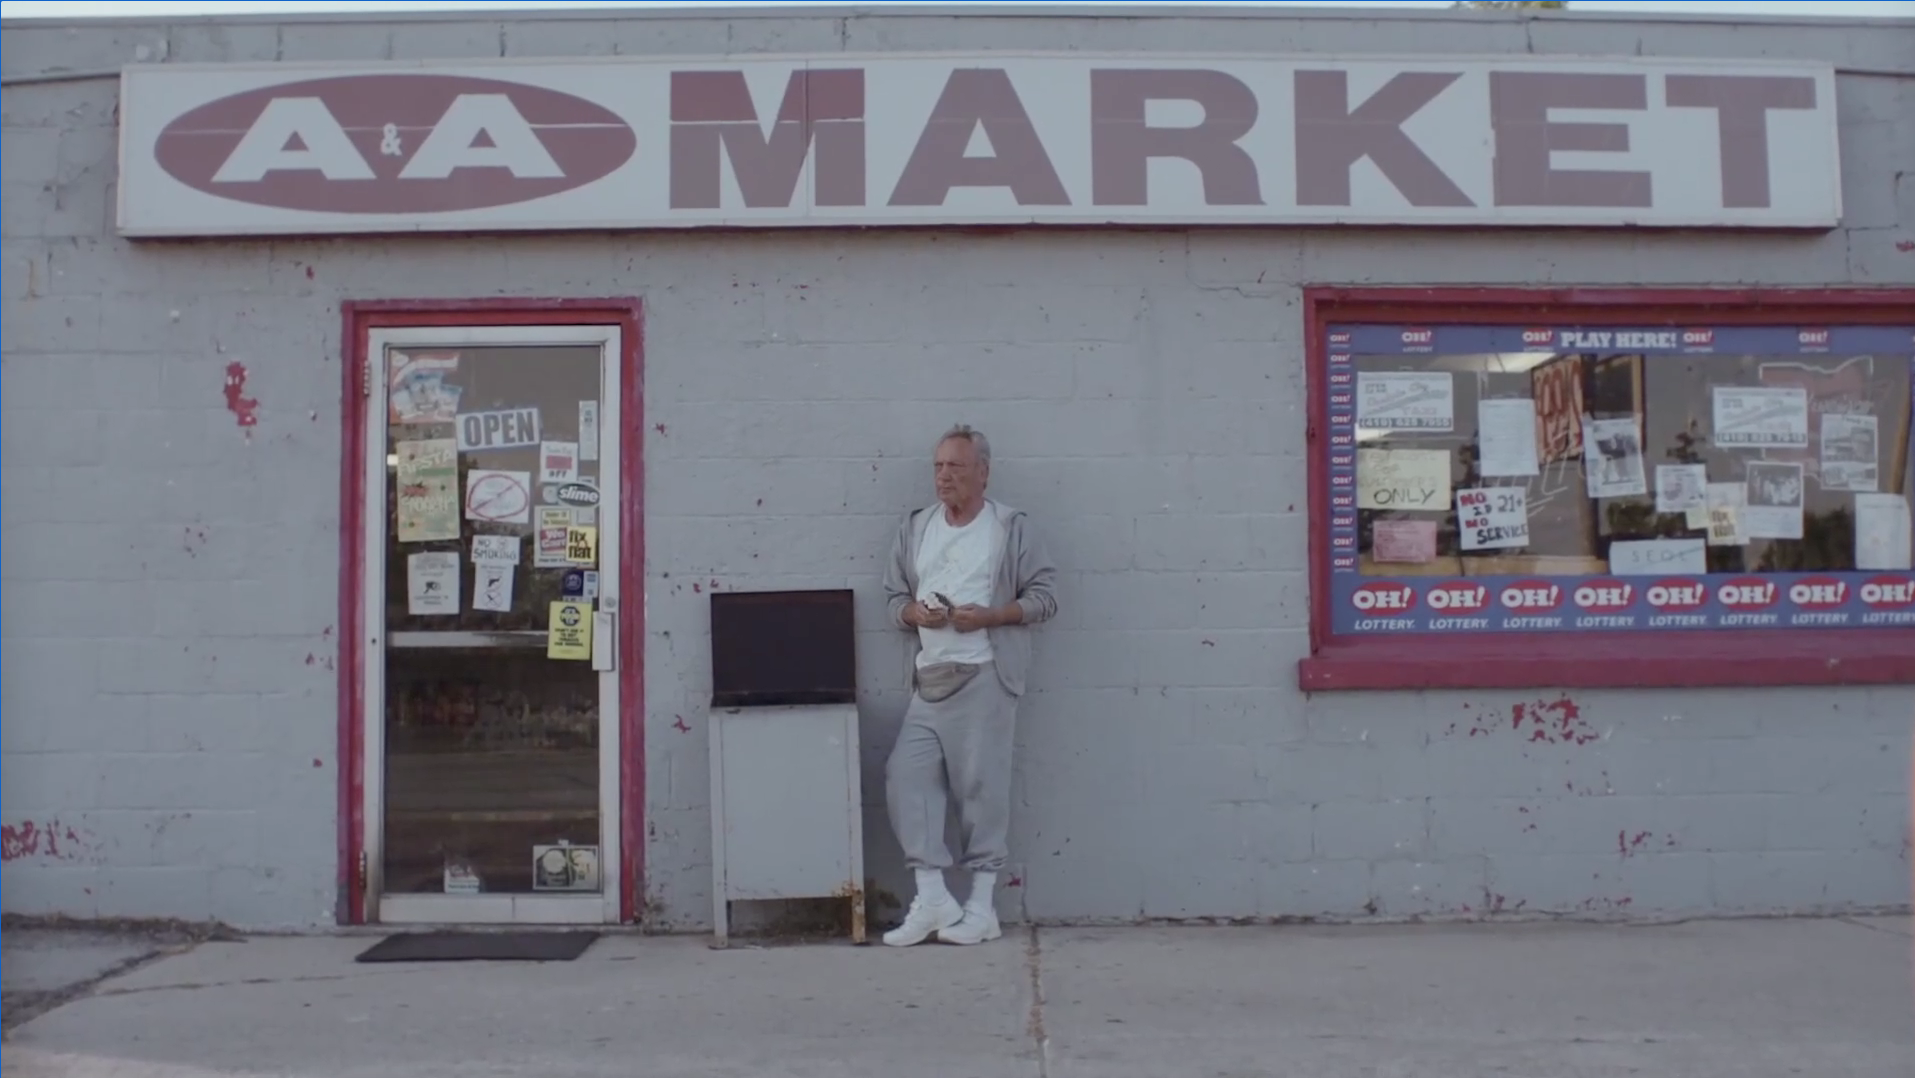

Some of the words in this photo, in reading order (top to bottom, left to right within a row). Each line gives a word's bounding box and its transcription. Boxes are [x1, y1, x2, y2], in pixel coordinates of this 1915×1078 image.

[670, 69, 1816, 209] MARKET
[1561, 332, 1612, 348] PLAY
[1616, 332, 1677, 348] HERE!
[464, 411, 534, 447] OPEN
[560, 484, 598, 502] slime
[1374, 488, 1436, 504] ONLY
[1497, 494, 1522, 512] 21+
[569, 530, 587, 543] fix
[1477, 524, 1528, 544] SERVICE
[478, 539, 490, 548] NO
[569, 546, 591, 558] flat
[474, 548, 516, 560] SMOKING
[1353, 587, 1411, 610] OH!
[1427, 586, 1485, 609] OH!
[1501, 585, 1559, 608] OH!
[1574, 584, 1632, 606] OH!
[1646, 584, 1704, 606] OH!
[1718, 583, 1774, 605] OH!
[1789, 582, 1846, 604] OH!
[1861, 581, 1915, 603] OH!
[1354, 619, 1414, 630] LOTTERY
[1428, 618, 1488, 630] LOTTERY
[1503, 617, 1561, 628] LOTTERY
[1576, 616, 1633, 627] LOTTERY
[1650, 615, 1706, 626] LOTTERY
[1720, 614, 1776, 625] LOTTERY
[1792, 614, 1848, 624] LOTTERY
